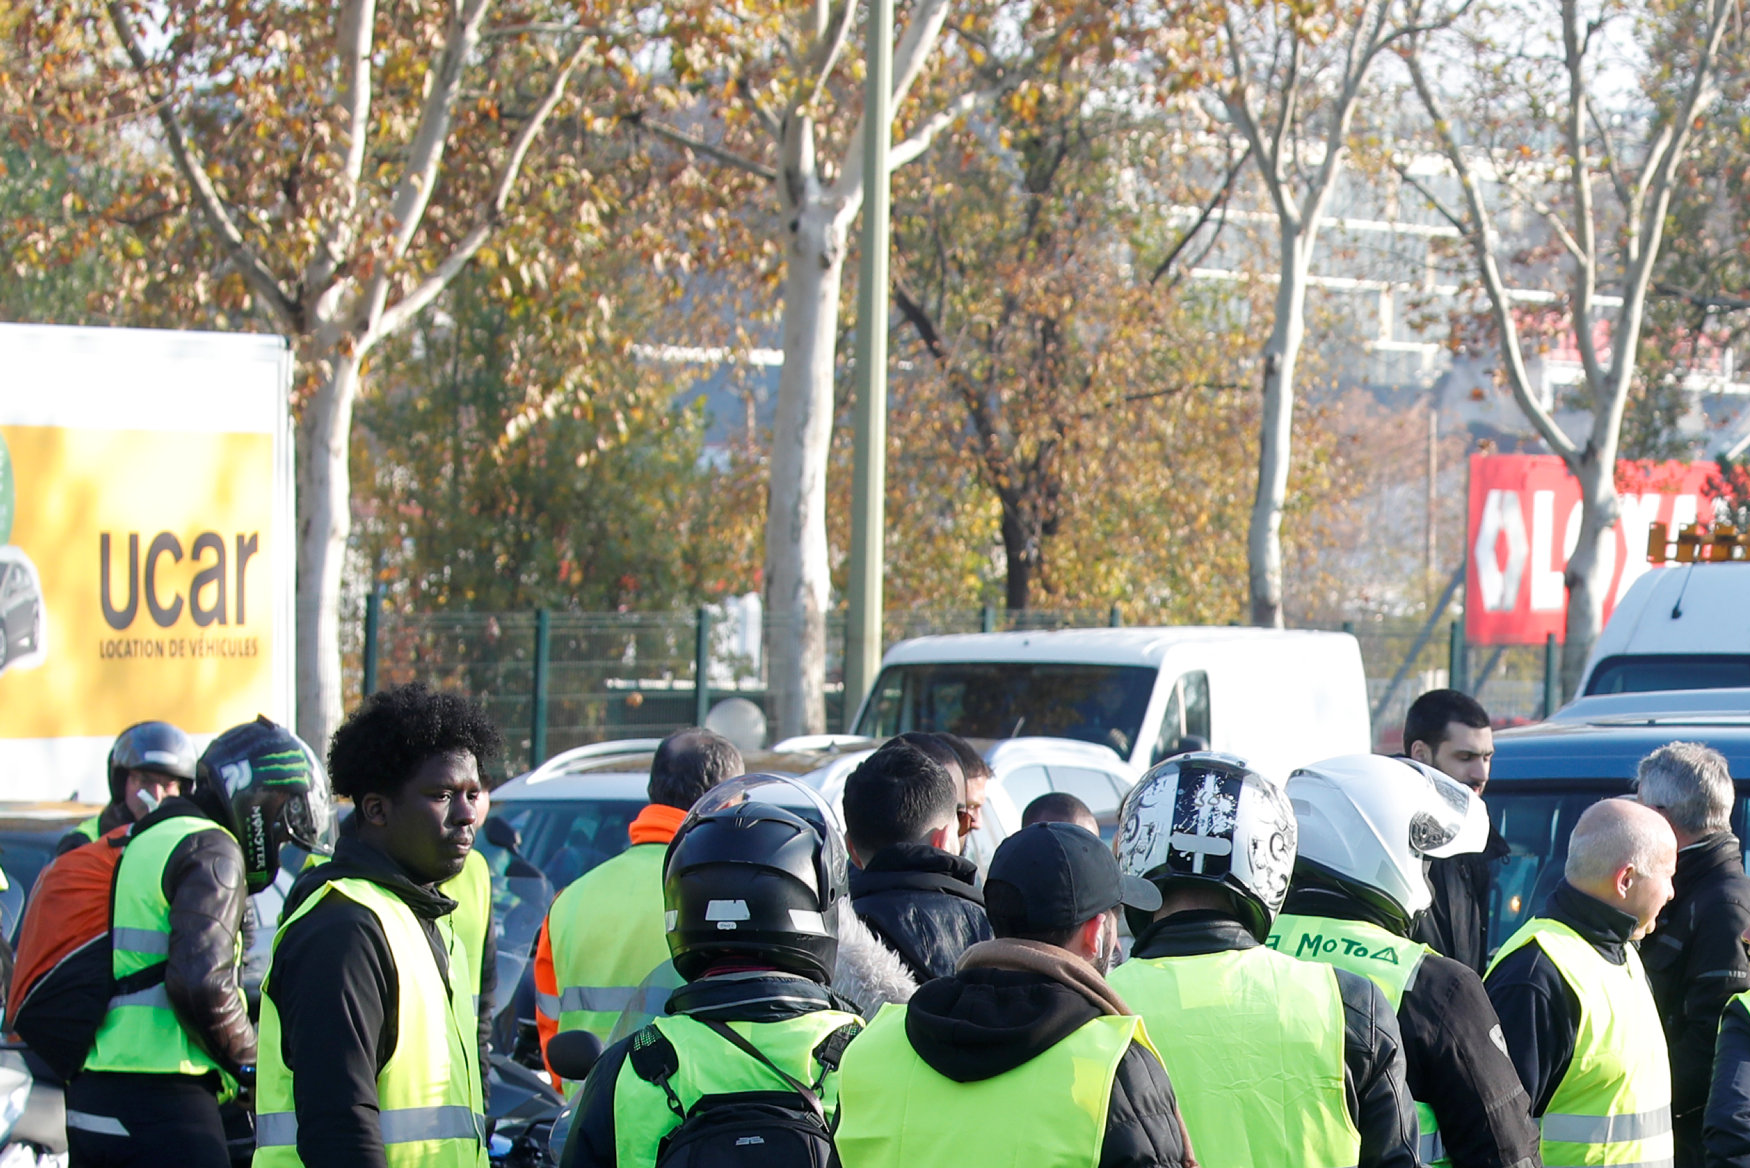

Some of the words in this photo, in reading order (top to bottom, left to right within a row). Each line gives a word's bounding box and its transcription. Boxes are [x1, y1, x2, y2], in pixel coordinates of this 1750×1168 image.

[99, 531, 258, 631] ucar
[99, 639, 164, 659] LOCATION
[168, 638, 185, 658] DE
[188, 632, 258, 658] VÉHICULES
[252, 806, 265, 870] MONSTER
